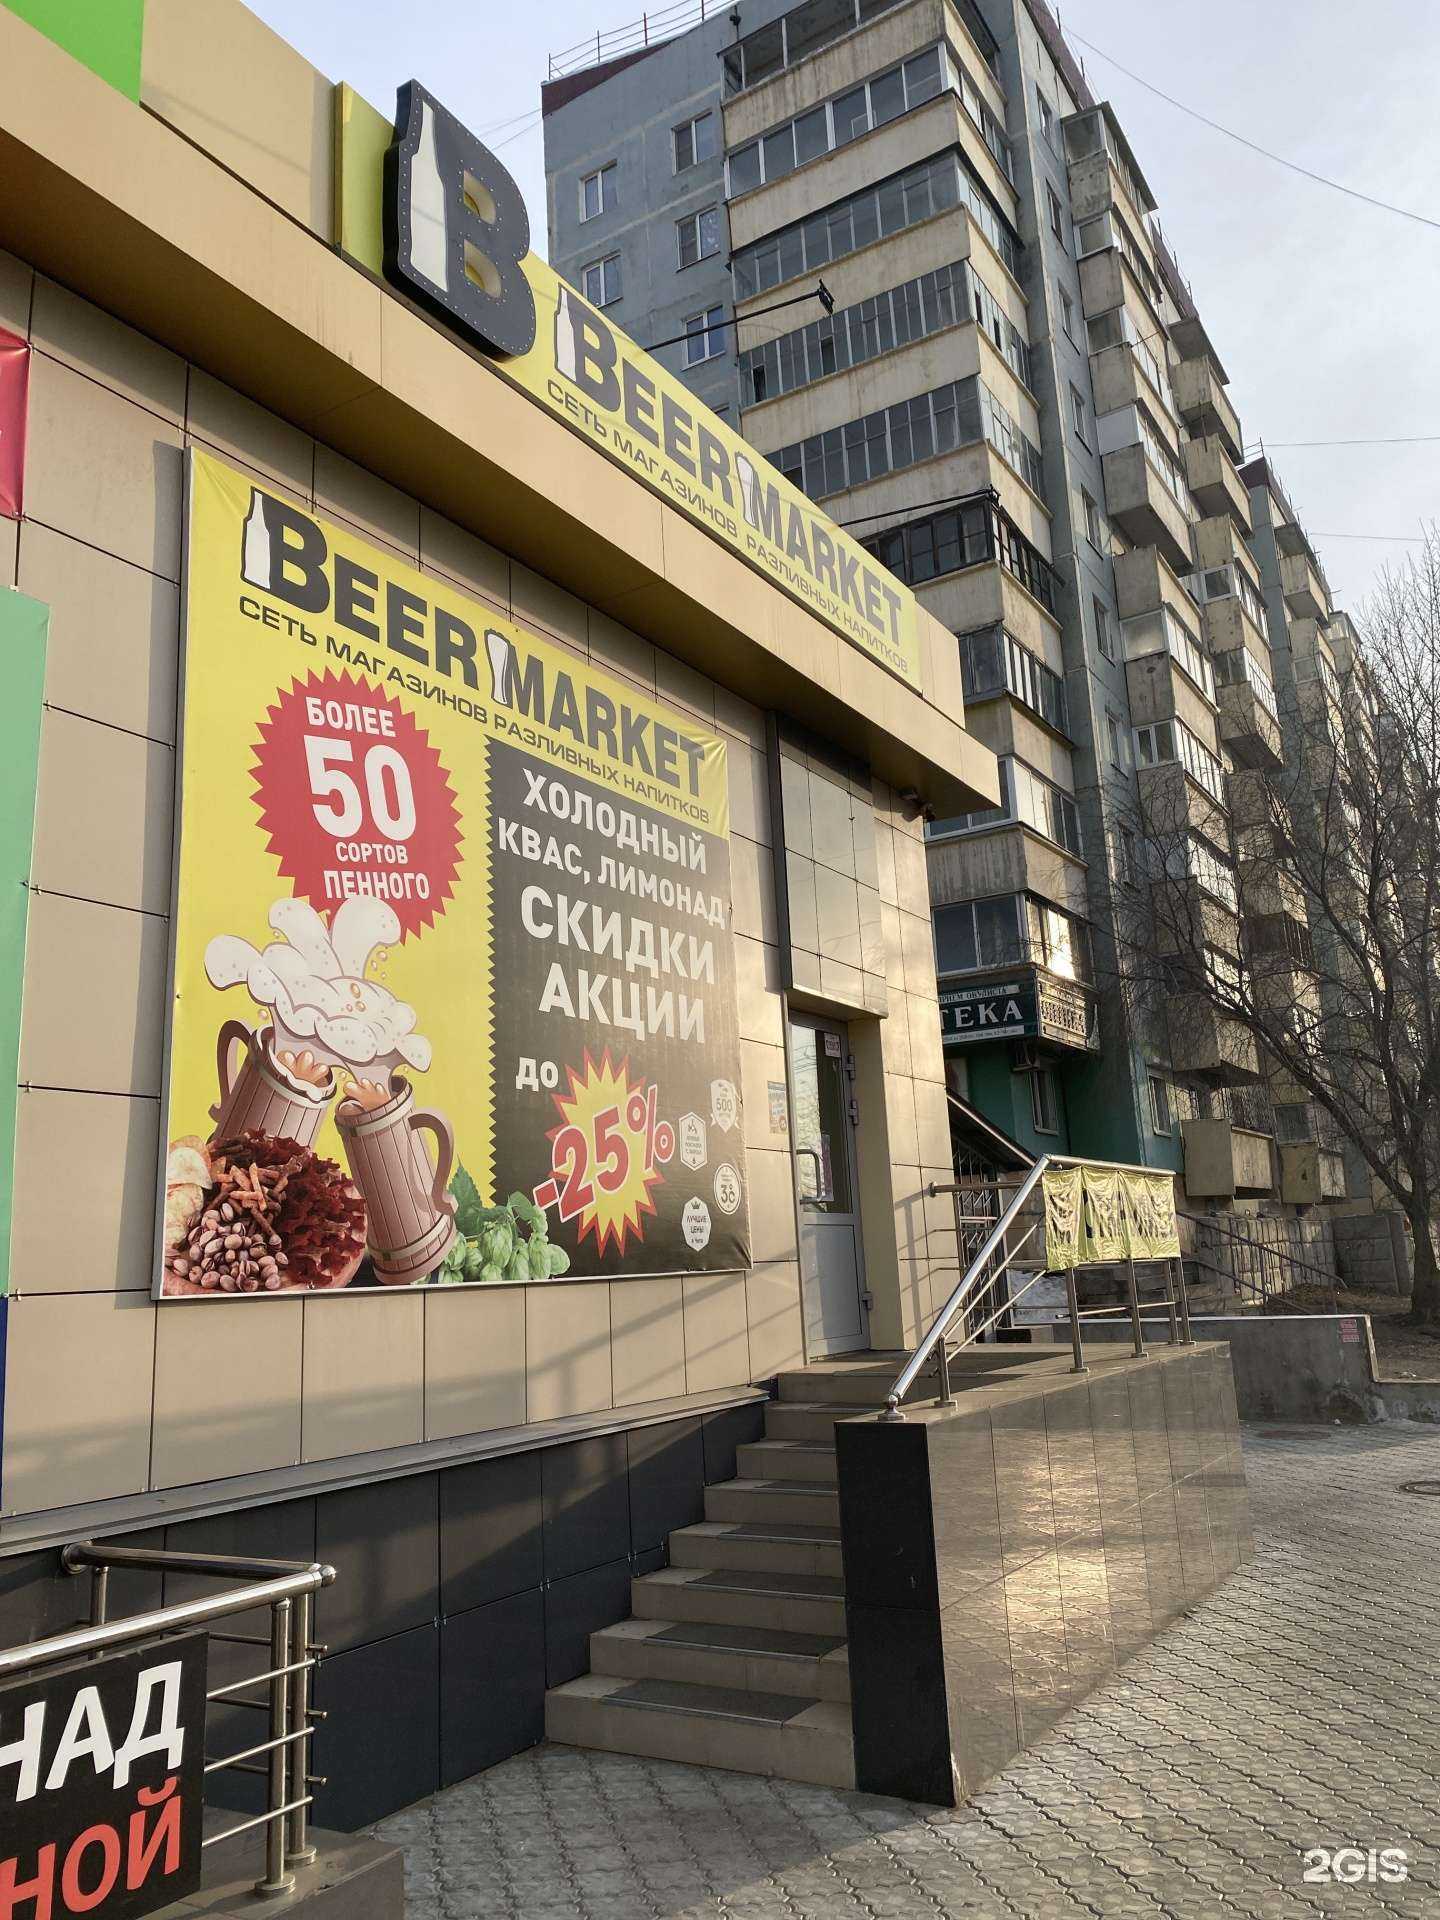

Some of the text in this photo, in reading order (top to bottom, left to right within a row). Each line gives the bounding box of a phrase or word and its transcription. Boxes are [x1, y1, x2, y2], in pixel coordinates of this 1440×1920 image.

[547, 379, 909, 674] СЕТЬ МАГАЗИНОВ РАЗЛИВНЫХ НАПИТКОВ
[750, 479, 901, 646] MARKET
[239, 595, 710, 825] СЕТЬ МАГАЗИНОВ РАЗЛИВНЫХ НАПИТКОВ
[305, 696, 396, 738] БОЛЕЕ
[506, 645, 706, 796] MARKET
[303, 734, 417, 841] 50
[522, 767, 707, 875] ХОЛОДНЫЙ
[323, 869, 430, 900] ПЕННОГО
[335, 841, 409, 864] СОРТОВ
[498, 817, 726, 930] КВАС, ЛИМОНАД
[520, 885, 715, 985] СКИДКИ
[538, 962, 705, 1044] АКЦИИ
[533, 1084, 675, 1223] -25%
